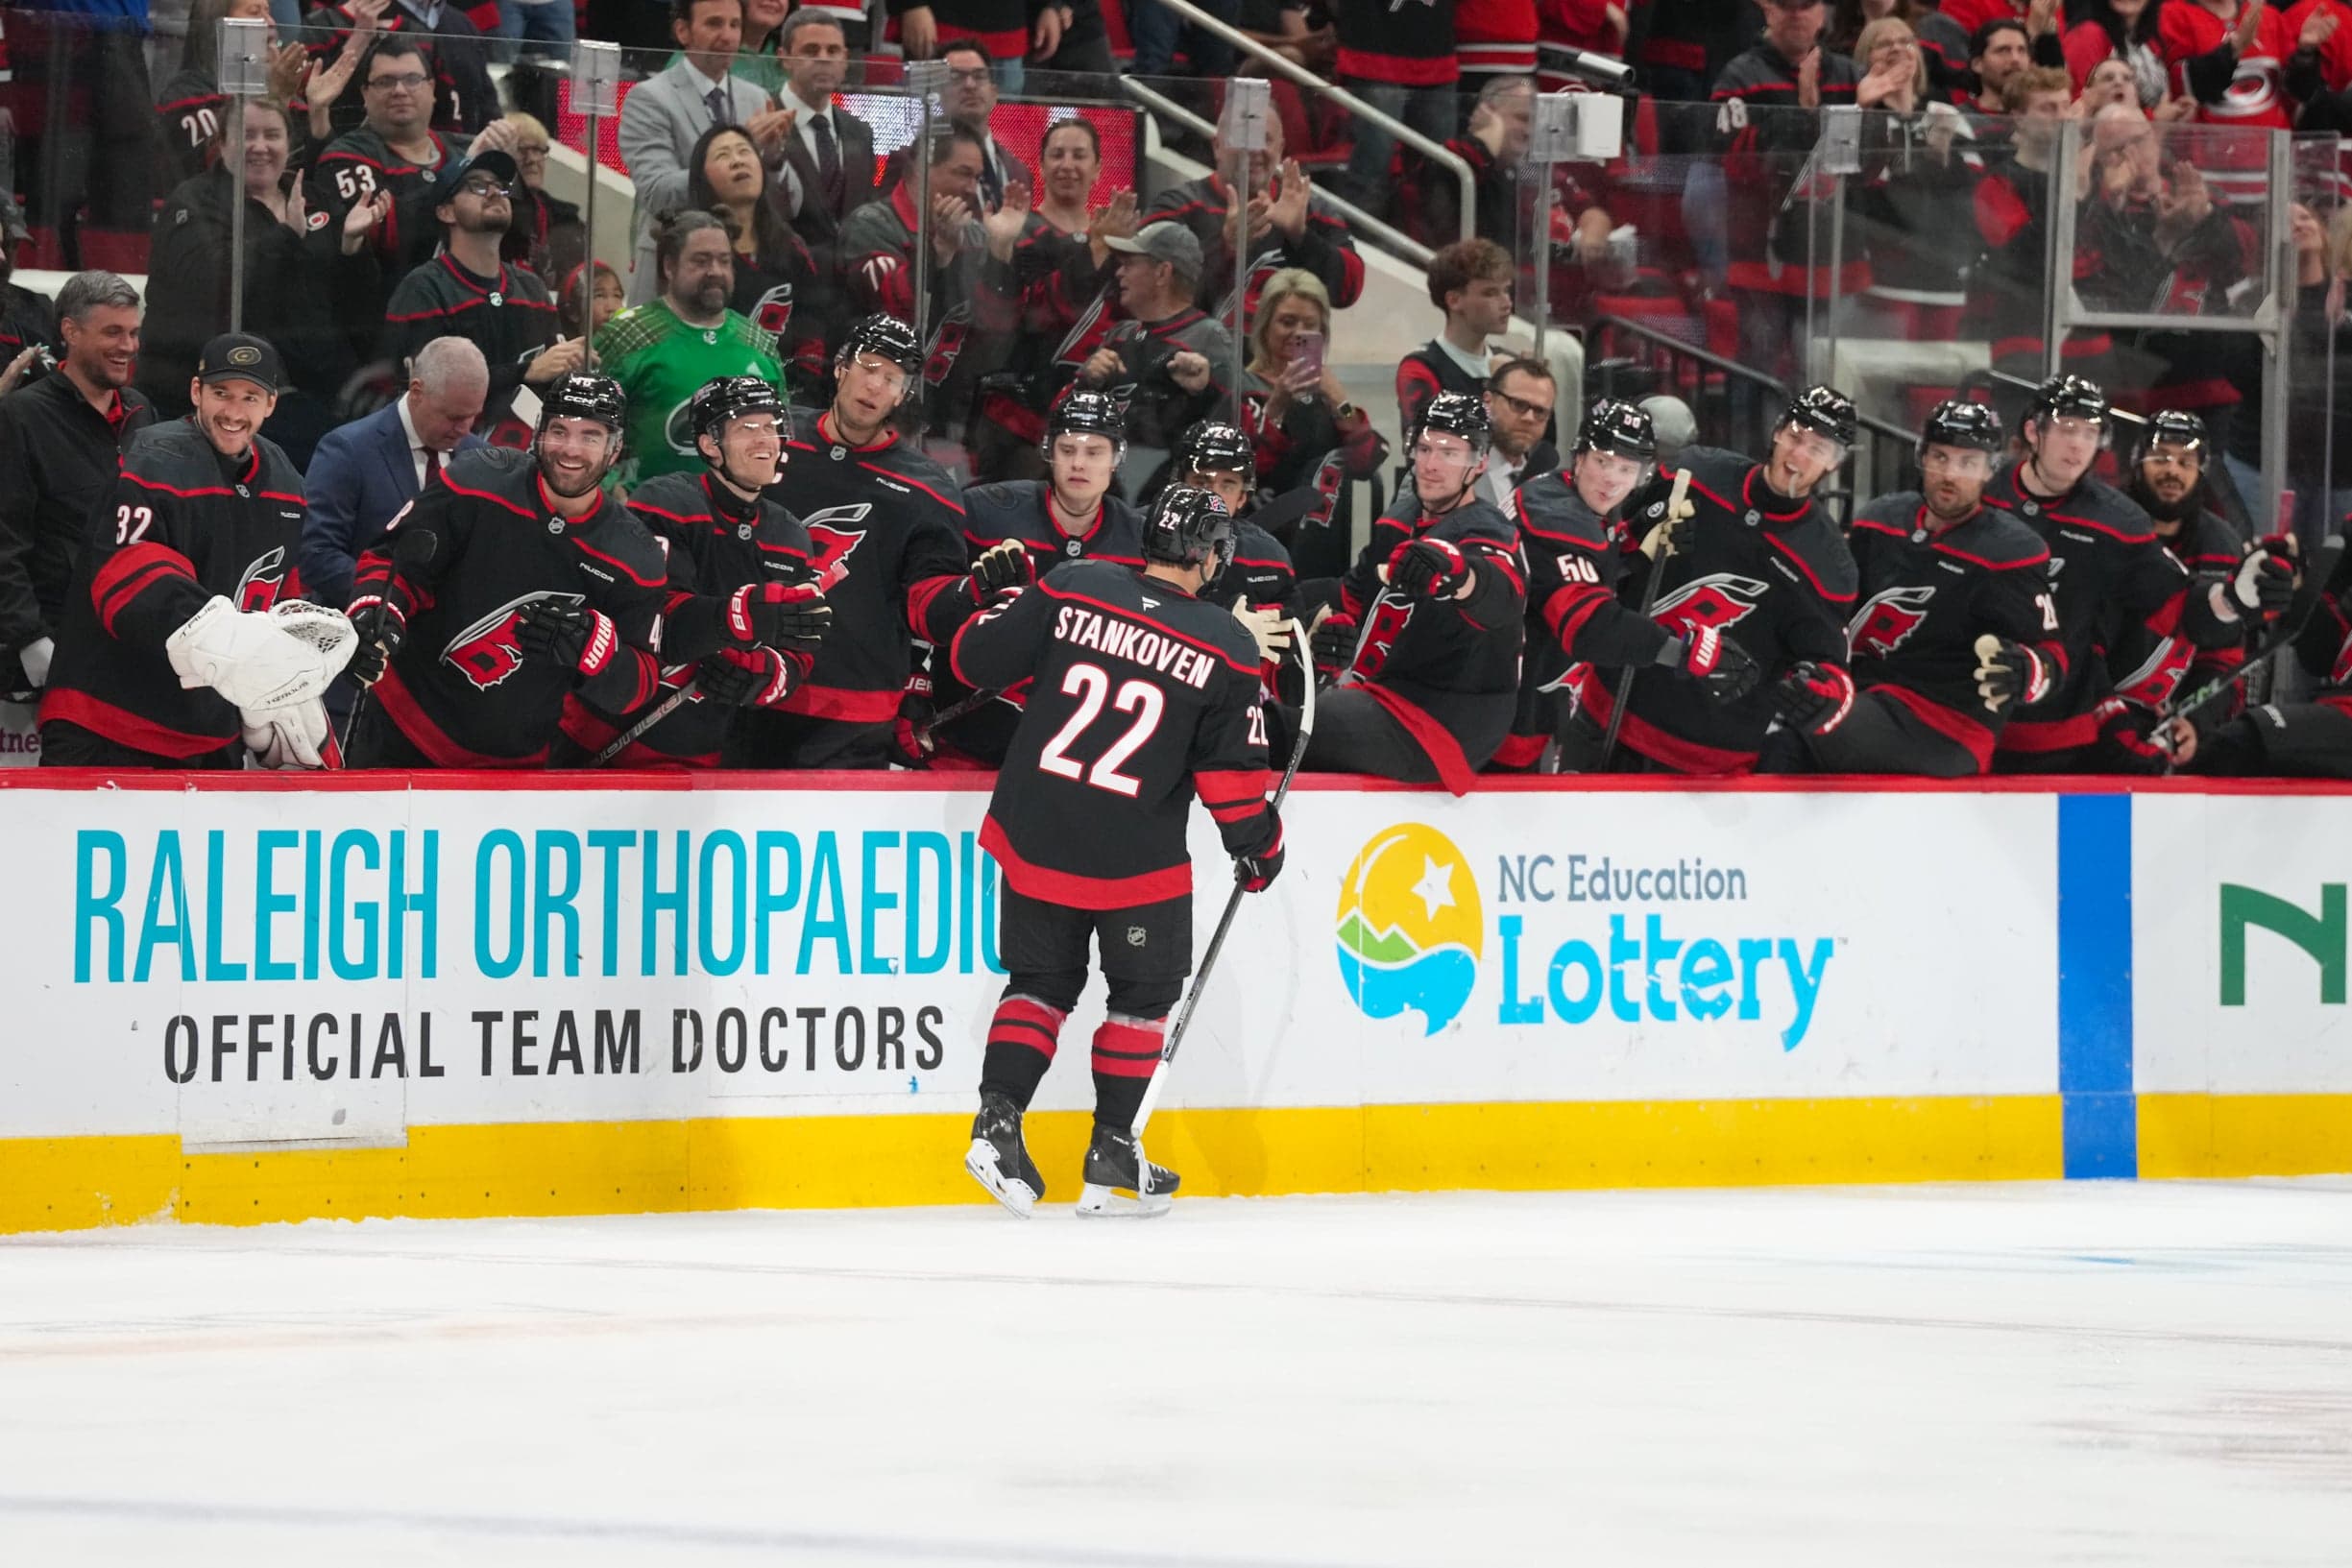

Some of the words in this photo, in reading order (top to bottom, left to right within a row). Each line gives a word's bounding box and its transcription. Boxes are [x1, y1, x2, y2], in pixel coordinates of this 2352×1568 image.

[181, 108, 219, 148] 20
[335, 164, 376, 200] 53
[115, 505, 153, 544] 32
[578, 561, 616, 583] NUCOR
[1557, 553, 1600, 584] 50
[1054, 605, 1216, 690] STANKOVEN
[1038, 662, 1166, 799] 22
[74, 829, 439, 983] RALEIGH
[1497, 854, 1555, 902] NC
[1567, 857, 1746, 902] Education
[2219, 882, 2347, 1006] N
[1498, 913, 1833, 1052] Lottery
[164, 1011, 445, 1084] OFFICIAL
[472, 1009, 641, 1076] TEAM
[672, 1005, 944, 1073] DOCTORS
